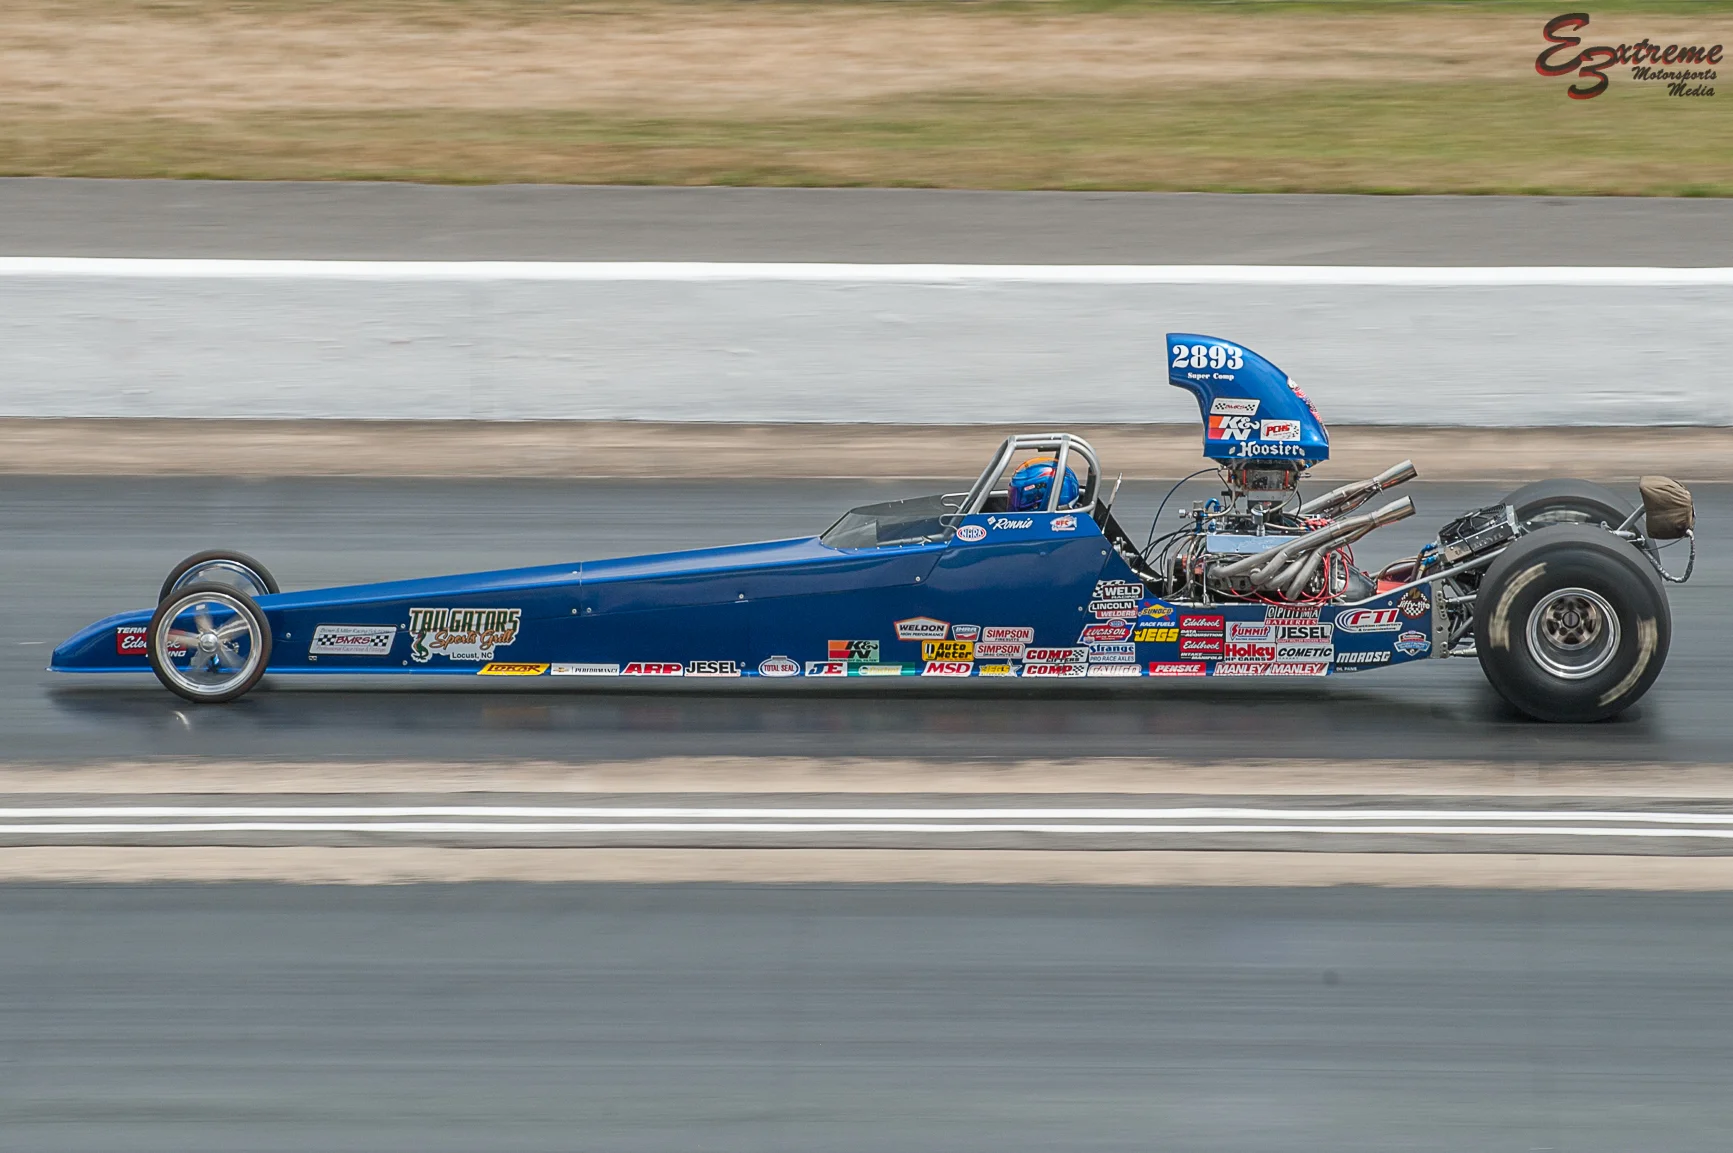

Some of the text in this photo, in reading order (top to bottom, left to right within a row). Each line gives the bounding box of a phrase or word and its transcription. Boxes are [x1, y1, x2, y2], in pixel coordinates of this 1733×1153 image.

[1172, 345, 1244, 369] 2893
[1188, 372, 1235, 381] Super Comp
[1237, 441, 1299, 457] Hoosier
[993, 517, 1033, 530] Ronnie
[961, 528, 982, 539] NHRA
[1104, 586, 1140, 596] WELD
[1091, 602, 1131, 610] LINCOLN
[1142, 607, 1174, 615] SUNOCO
[411, 610, 519, 632] TAILGATORS
[1350, 610, 1397, 624] FTI
[1183, 618, 1220, 627] Edelbrock
[987, 630, 1029, 638] SIMPSON
[1134, 628, 1179, 642] JEGS
[1279, 627, 1329, 638] JESEL
[335, 636, 371, 645] BMRS
[429, 629, 515, 650] Sports Grill
[937, 643, 966, 651] Auto
[1090, 644, 1135, 653] Strange
[1183, 641, 1219, 649] Edelbrock
[452, 652, 479, 660] Locust,
[935, 651, 972, 660] Meter
[1026, 650, 1073, 660] COMP
[1225, 644, 1275, 661] Holley
[1278, 647, 1332, 657] COMETIC
[624, 663, 682, 674] ARP
[686, 662, 738, 674] JESEL
[808, 663, 843, 675] JE
[927, 663, 970, 673] MSD
[1027, 665, 1073, 674] COMP
[1155, 664, 1201, 672] PENSKE
[1216, 664, 1265, 674] MANLEY
[1271, 664, 1321, 674] MANLEY
